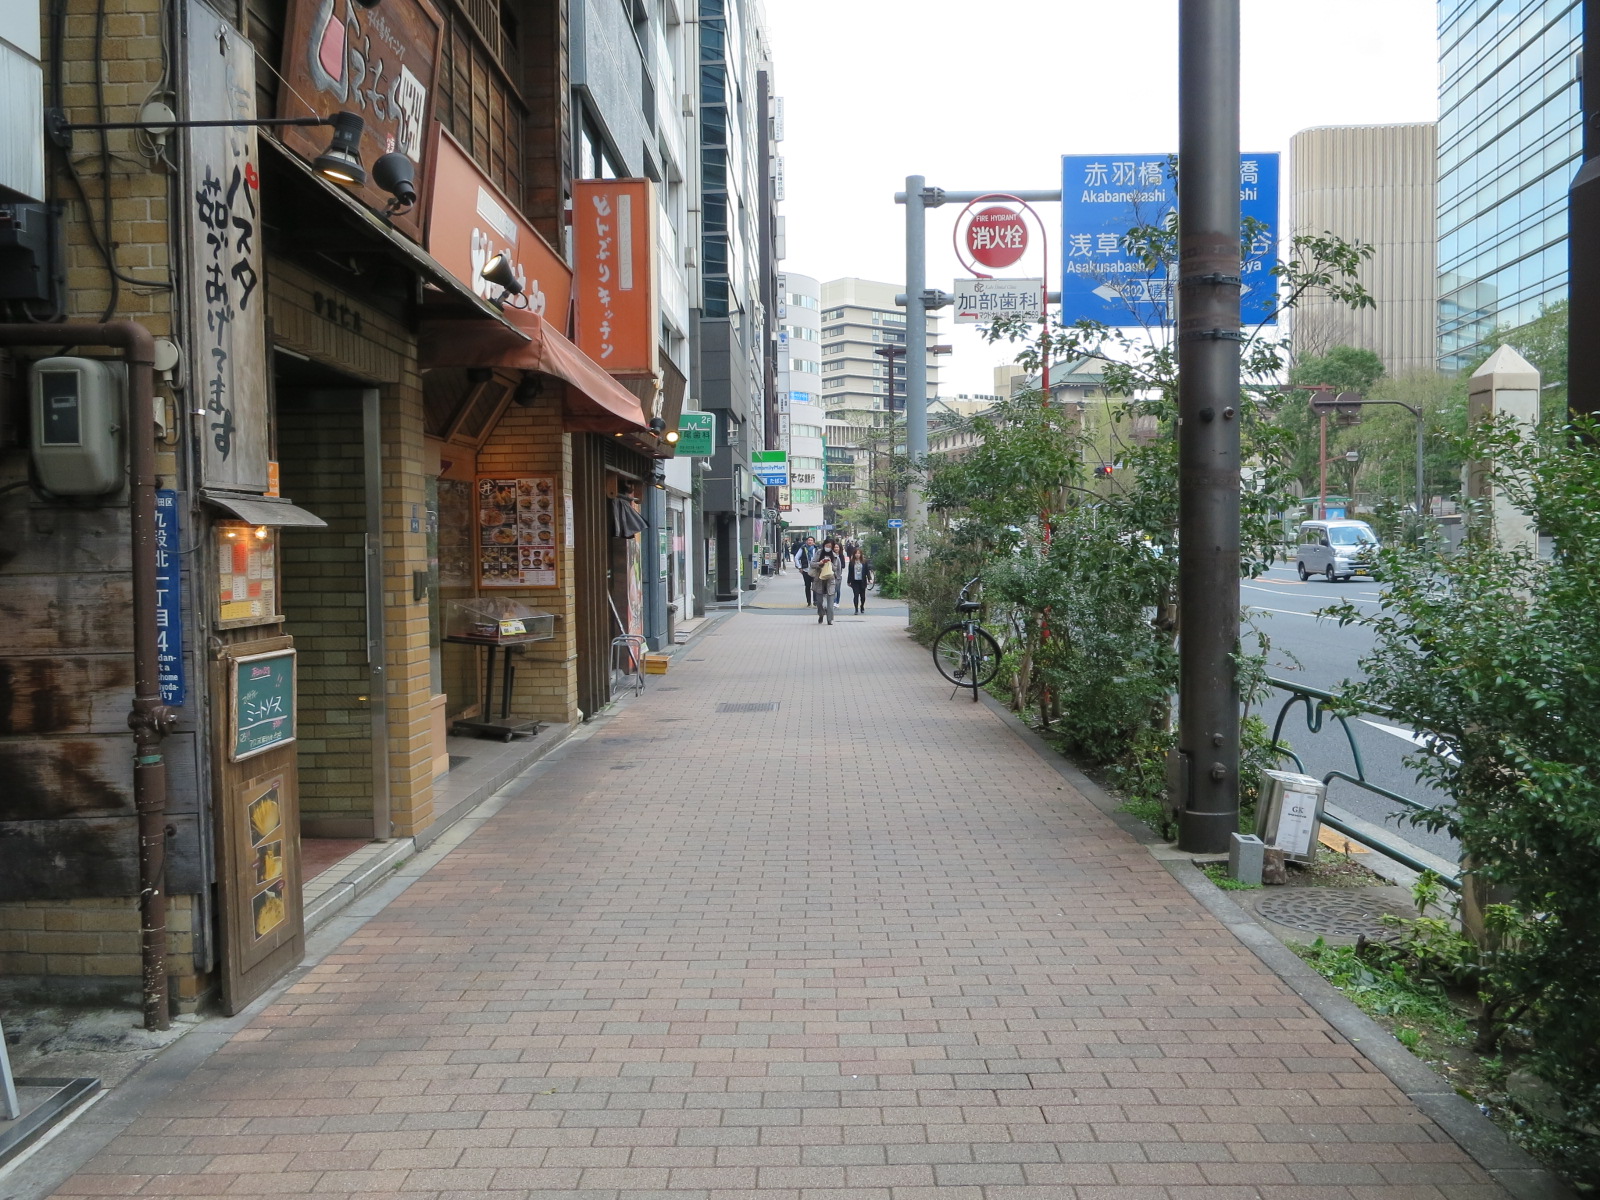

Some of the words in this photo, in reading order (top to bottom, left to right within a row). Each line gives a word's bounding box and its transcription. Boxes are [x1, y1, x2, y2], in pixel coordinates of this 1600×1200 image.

[1084, 162, 1163, 187] 赤羽橋
[1081, 189, 1165, 203] Akabanebashi
[990, 214, 1017, 222] HYDRANT
[972, 225, 1023, 249] 消火栓
[592, 194, 614, 358] どんぶりキッチン
[1125, 285, 1143, 297] 302
[958, 292, 1038, 310] 加部歯科
[701, 416, 711, 424] 2F
[680, 431, 710, 440] 尾歯科
[155, 497, 173, 507] 田区
[158, 654, 177, 662] dan-
[159, 691, 173, 700] ity
[246, 696, 282, 722] ミートソース
